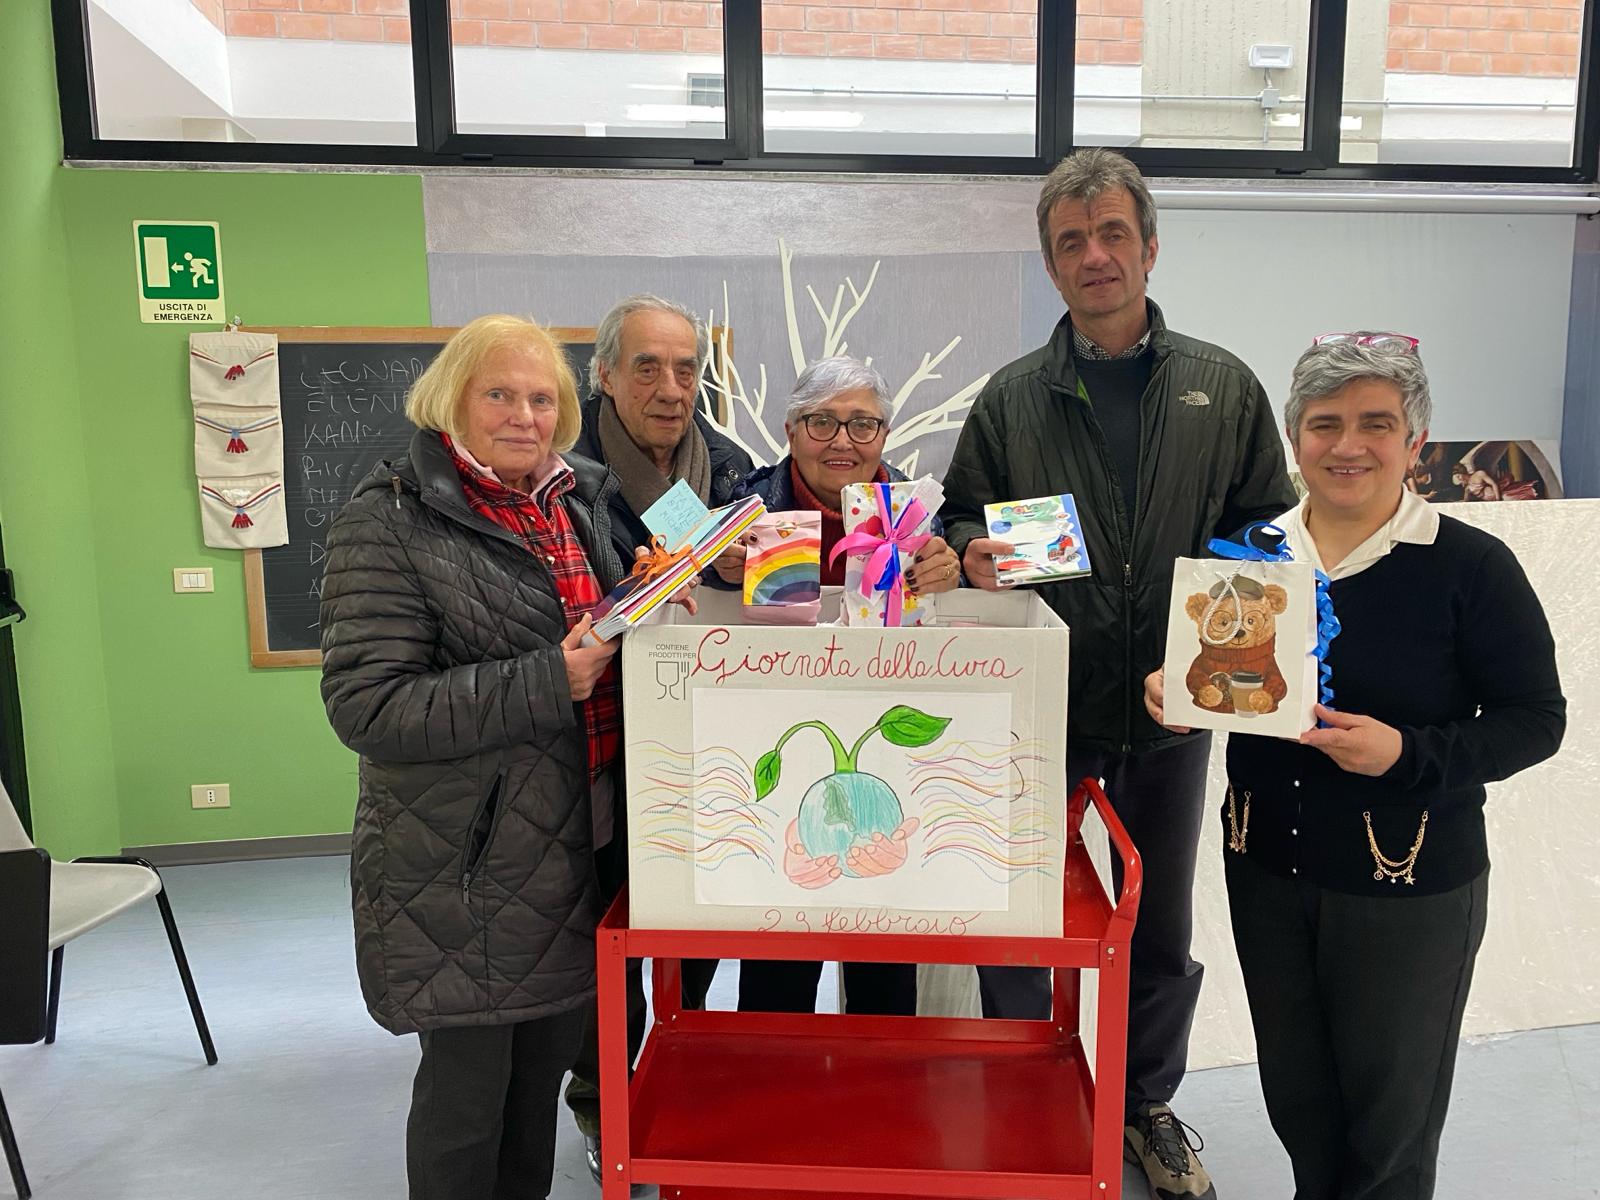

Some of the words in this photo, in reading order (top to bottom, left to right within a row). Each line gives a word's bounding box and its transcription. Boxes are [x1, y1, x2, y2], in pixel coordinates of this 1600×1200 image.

[159, 303, 194, 311] USCITA
[197, 303, 207, 311] DI
[153, 313, 213, 321] EMERGENZA
[655, 643, 689, 651] CONTIENE
[648, 651, 682, 659] PRODOTTI
[691, 628, 860, 685] Giornata
[867, 636, 933, 679] della
[930, 635, 1024, 679] Cura
[821, 907, 982, 936] febbraio
